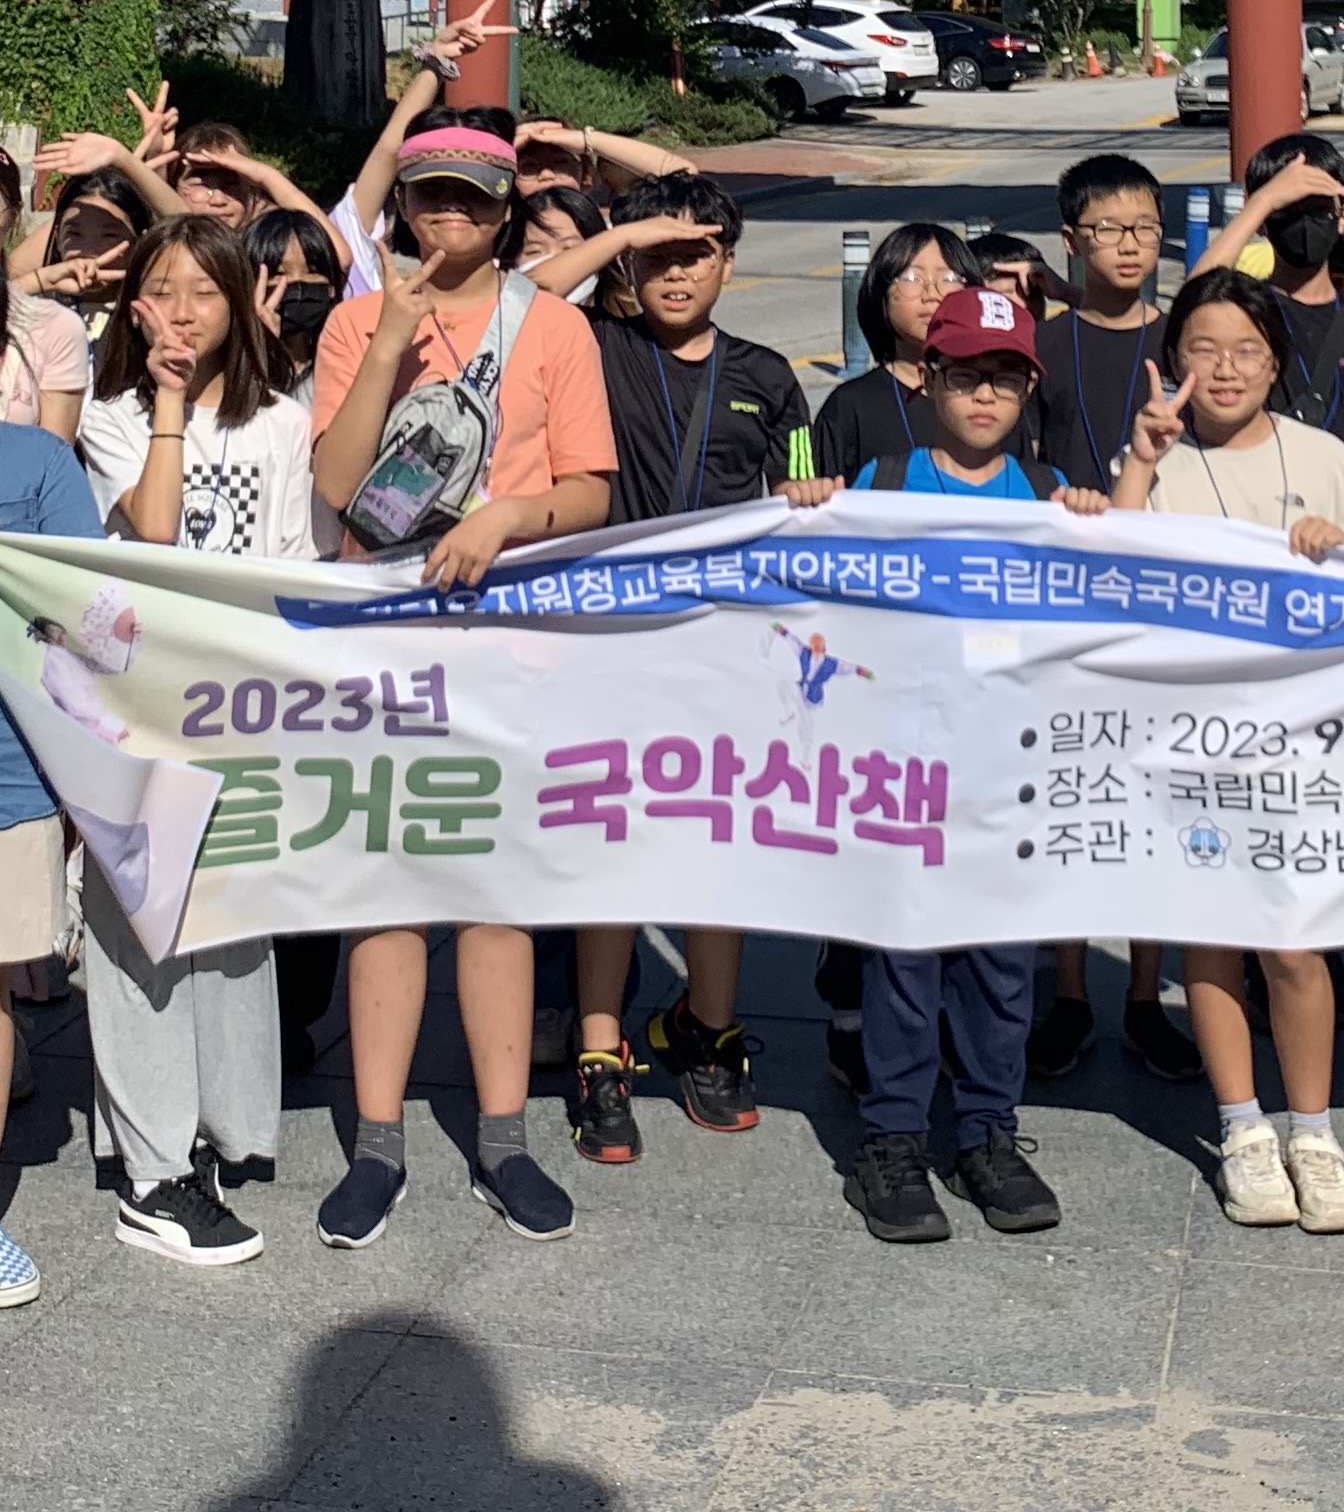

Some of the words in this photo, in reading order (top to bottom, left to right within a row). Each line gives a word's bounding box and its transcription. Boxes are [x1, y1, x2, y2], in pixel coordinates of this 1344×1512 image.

[181, 661, 452, 739] 2023년
[1049, 708, 1132, 755] 일자
[1168, 711, 1300, 759] 2023.
[187, 753, 503, 869] 즐거운
[536, 733, 950, 867] 국악산책
[1044, 762, 1130, 808] 장소
[1045, 819, 1130, 866] 주관
